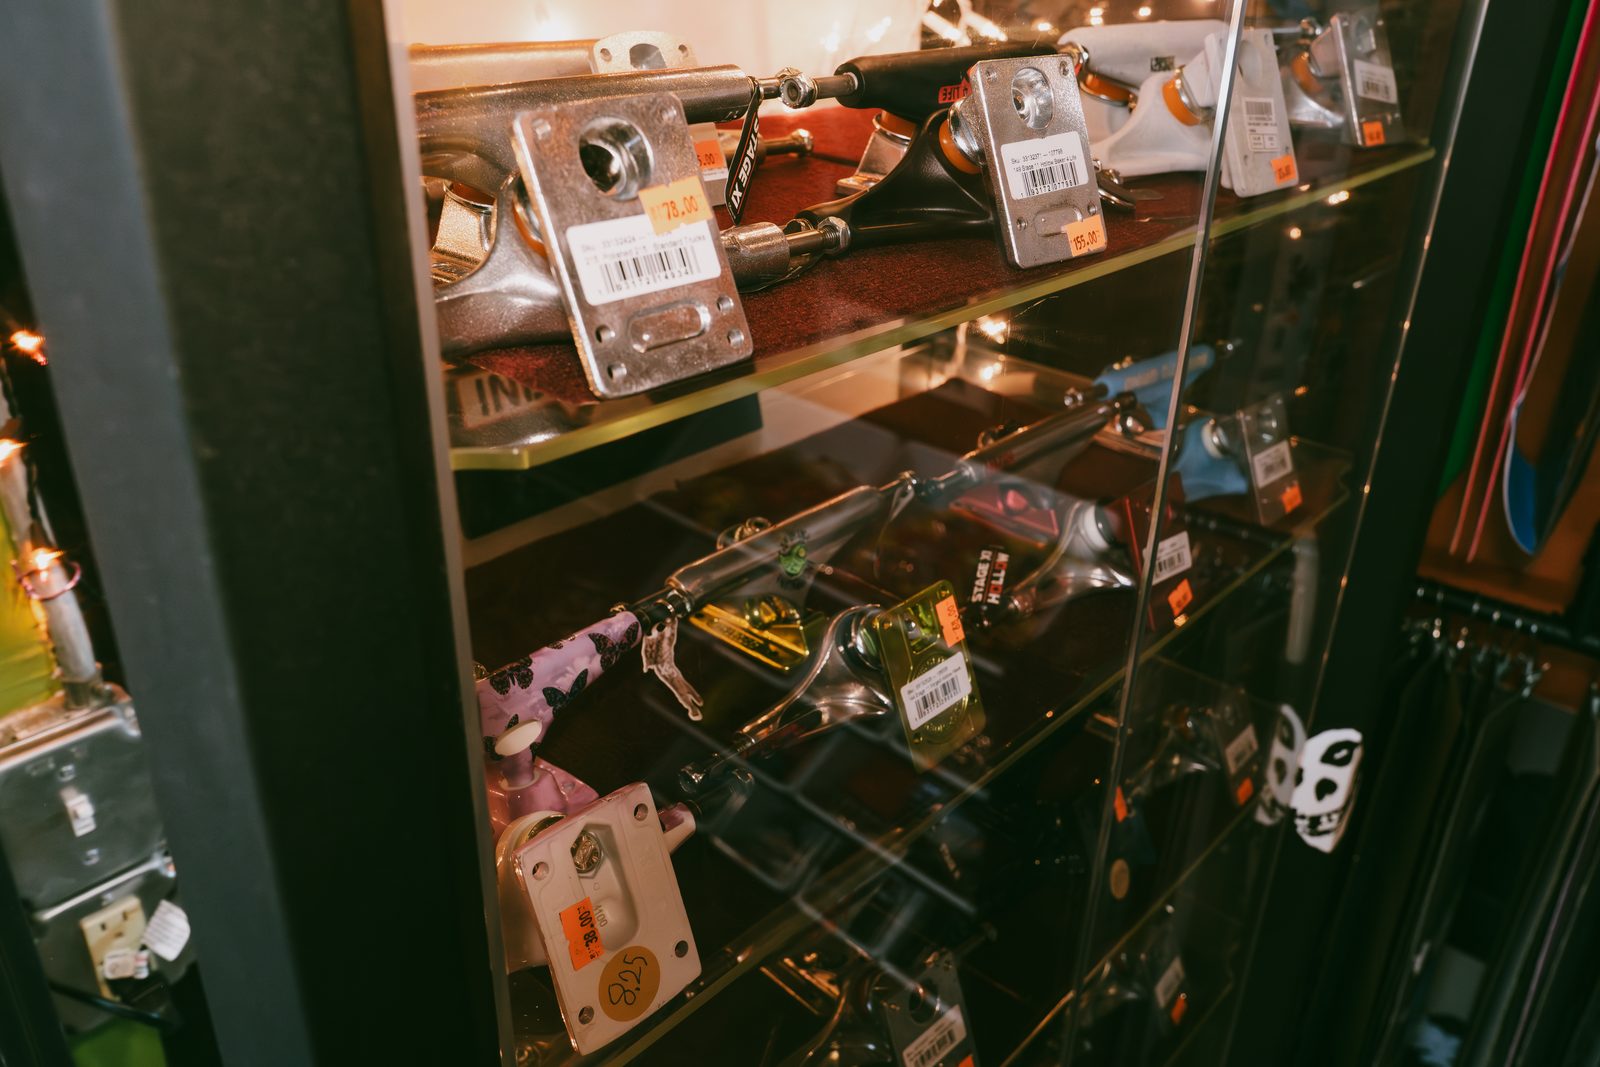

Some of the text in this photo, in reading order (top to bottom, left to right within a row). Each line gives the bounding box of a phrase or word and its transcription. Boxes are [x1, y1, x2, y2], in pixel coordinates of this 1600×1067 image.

[662, 195, 699, 221] 78.00
[731, 182, 743, 209] XI
[1073, 230, 1099, 251] 155.00
[971, 562, 990, 603] STAGE
[987, 552, 1009, 605] HOLLOW
[579, 910, 599, 951] 38.00
[608, 953, 648, 1006] 8.25
